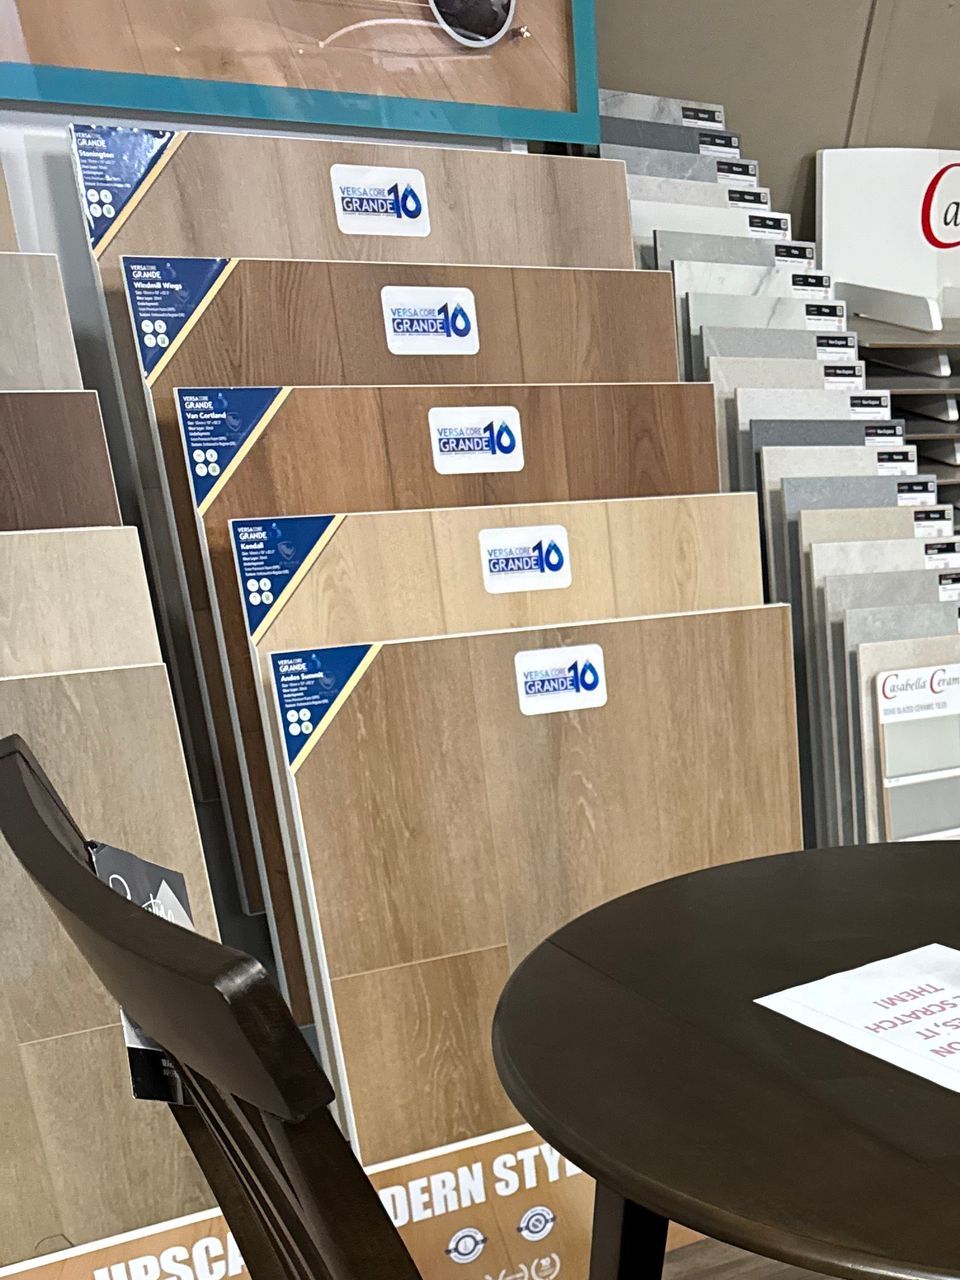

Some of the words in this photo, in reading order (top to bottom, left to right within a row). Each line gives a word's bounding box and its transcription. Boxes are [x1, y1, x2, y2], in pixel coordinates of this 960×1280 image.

[78, 139, 106, 148] GRANDE
[340, 186, 368, 196] VERSA
[343, 198, 394, 213] GRANDE
[391, 308, 418, 318] VERSA
[393, 319, 445, 332] GRANDE
[437, 428, 465, 437] VERSA
[440, 438, 489, 452] GRANDE
[239, 532, 268, 540] GRANDE
[488, 548, 514, 558] VERSA
[490, 557, 539, 572] GRANDE
[279, 663, 308, 672] GRANDE
[301, 672, 324, 680] Summit
[524, 670, 550, 680] VERSA
[526, 677, 574, 694] GRANDE
[882, 674, 928, 700] Casabella
[873, 984, 944, 1010] THEM!
[864, 1000, 958, 1034] SCRATCH
[916, 1028, 942, 1040] IT
